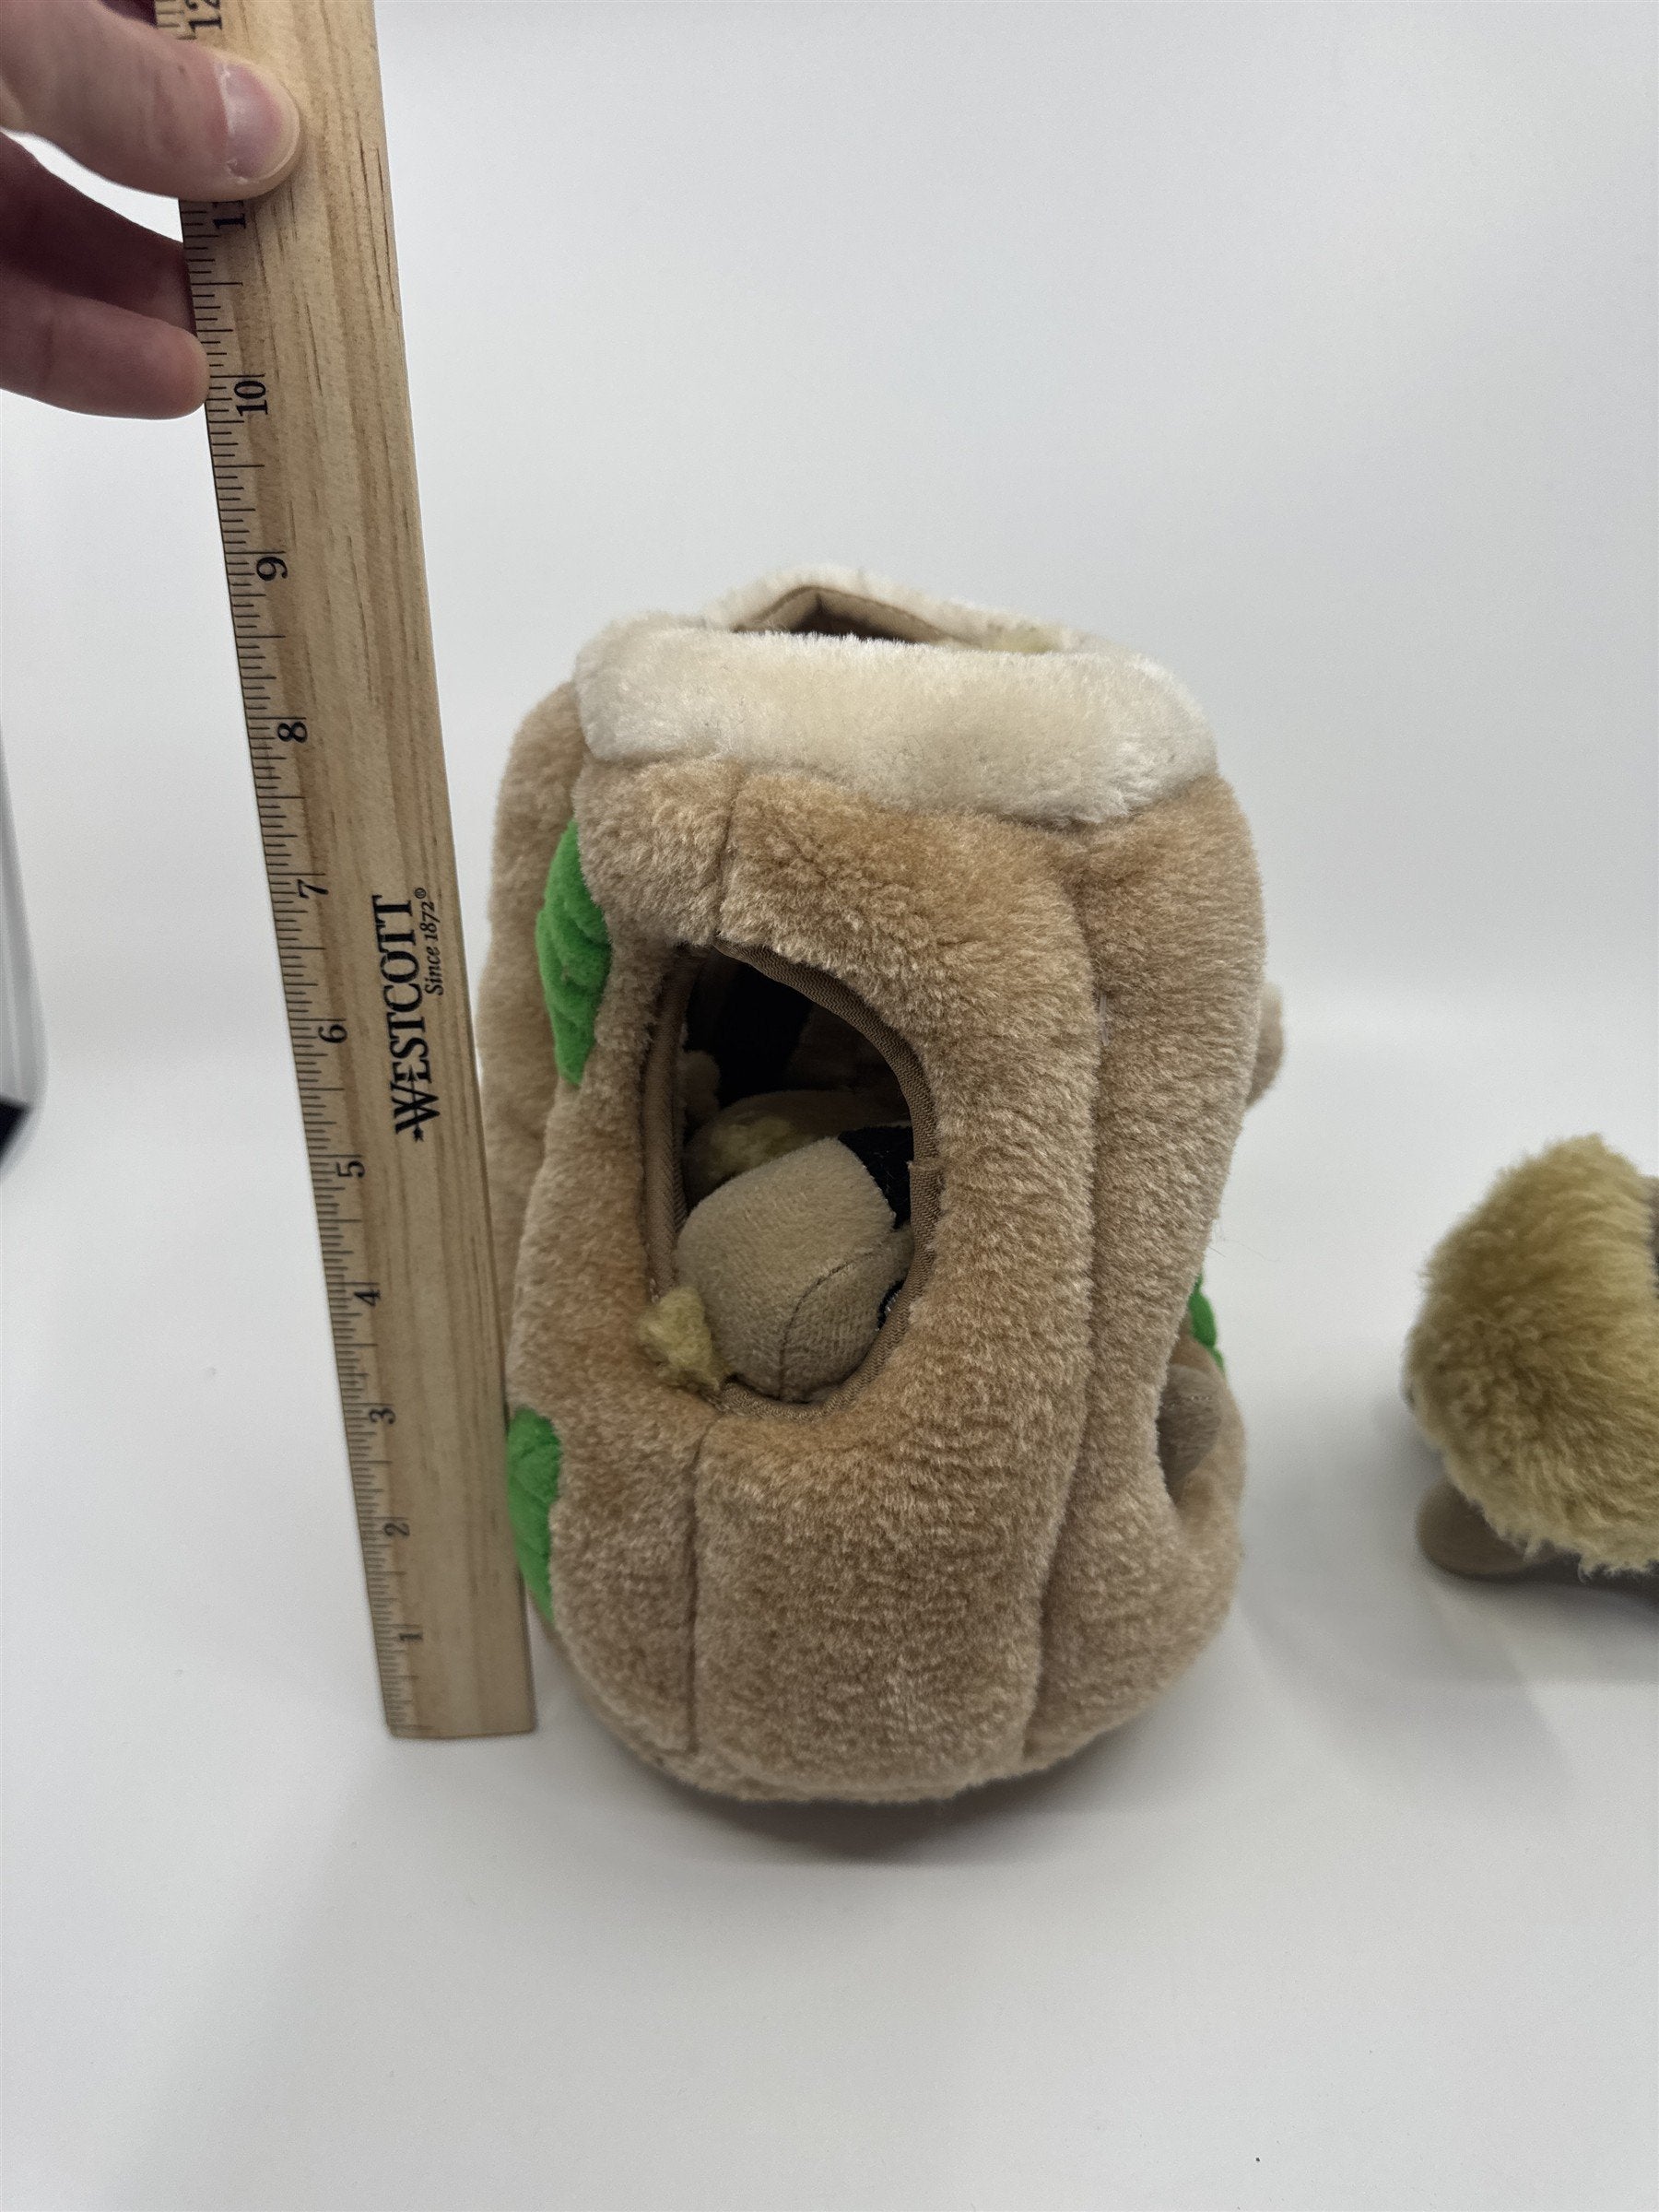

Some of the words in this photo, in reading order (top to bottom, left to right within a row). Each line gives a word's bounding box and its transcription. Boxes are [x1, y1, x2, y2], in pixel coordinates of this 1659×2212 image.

[233, 380, 268, 416] 10
[256, 556, 288, 582] 9
[277, 721, 308, 744] 8
[297, 878, 329, 900] 7
[424, 946, 444, 996] Since
[371, 893, 441, 1134] WESTCOTT
[318, 1024, 348, 1043] 6
[336, 1159, 366, 1179] 5
[353, 1289, 381, 1307] 4
[369, 1406, 396, 1425] 3
[383, 1521, 410, 1538] 2
[398, 1632, 424, 1642] 1
